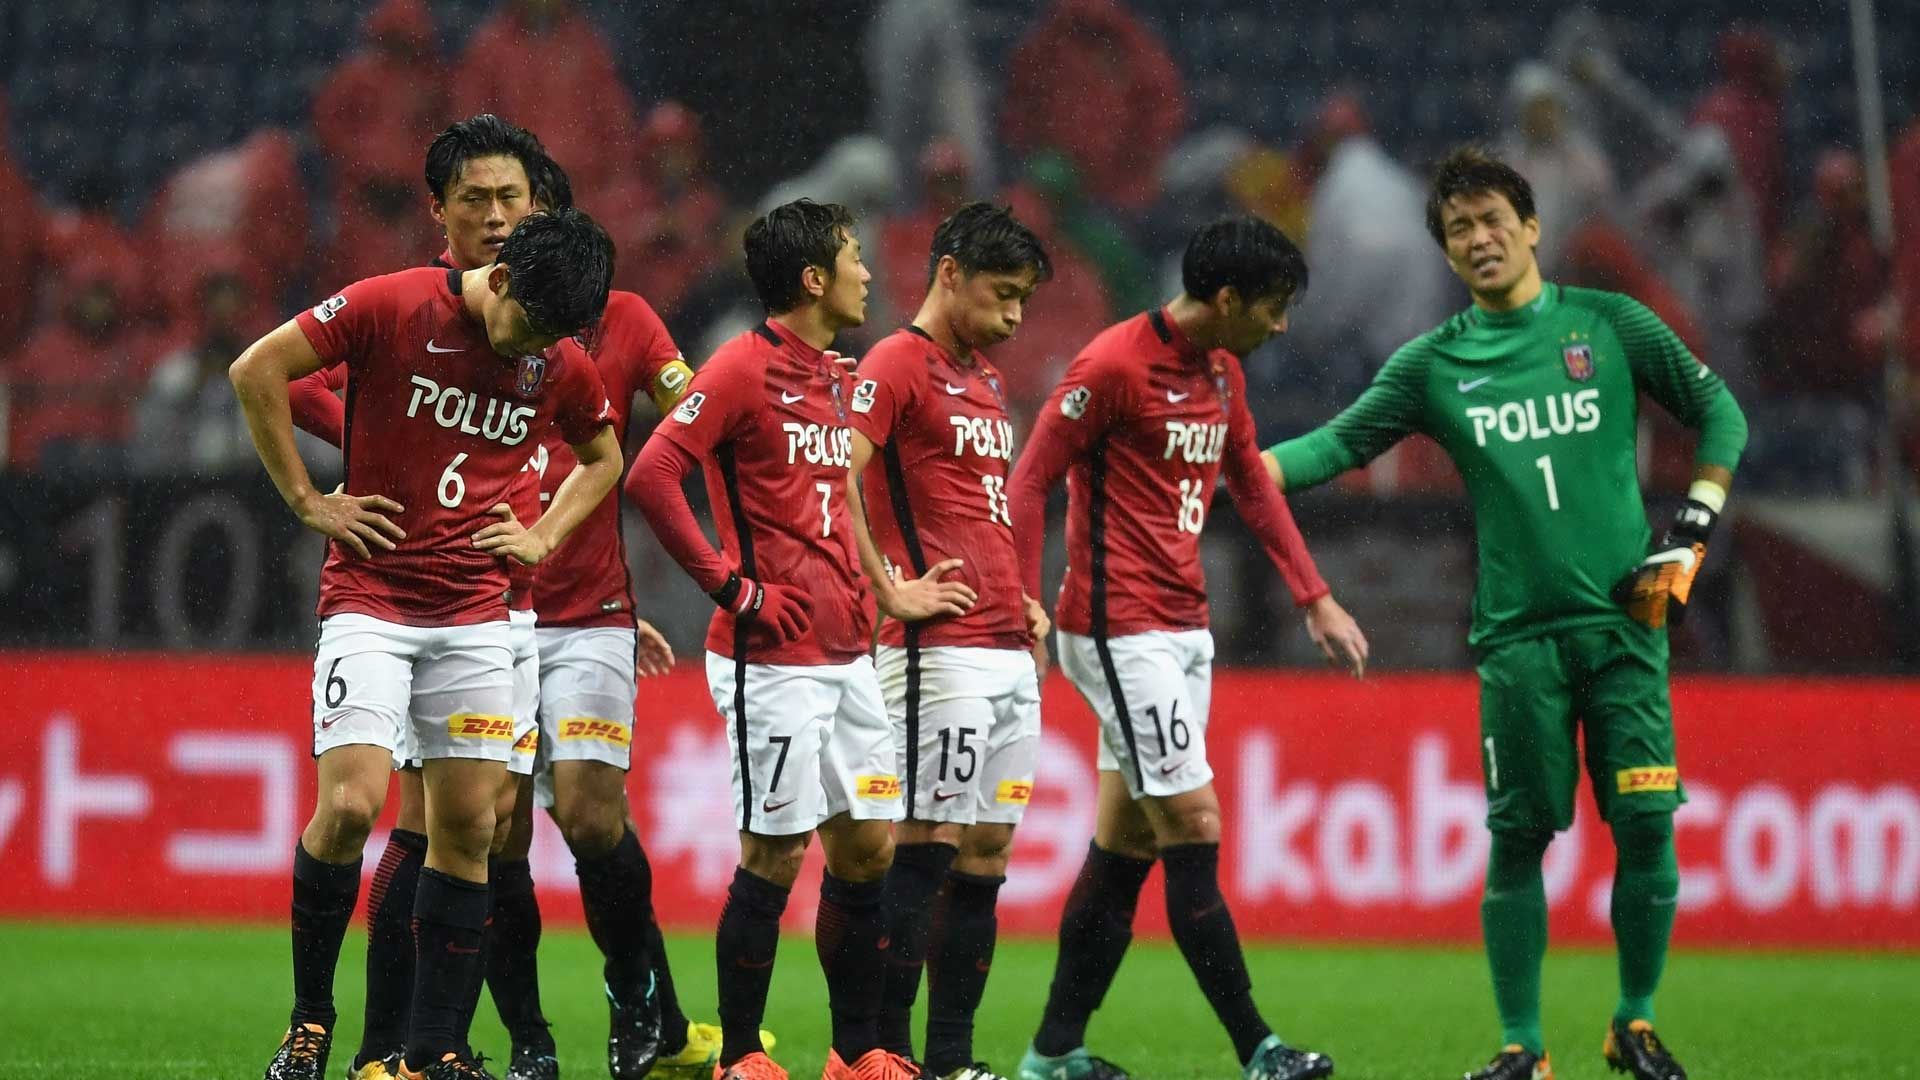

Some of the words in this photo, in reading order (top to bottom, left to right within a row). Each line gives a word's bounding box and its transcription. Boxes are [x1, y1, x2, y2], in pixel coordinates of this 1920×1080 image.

[407, 375, 536, 446] POLUS
[1466, 388, 1600, 447] POLUS
[950, 416, 1013, 462] POLU
[1164, 421, 1228, 464] POLU
[437, 453, 468, 508] 6
[1178, 478, 1204, 534] 16
[1536, 455, 1560, 510] 1
[816, 483, 831, 538] 7
[325, 656, 347, 709] 6
[565, 721, 624, 742] DHL
[937, 727, 976, 783] 15
[1145, 699, 1189, 757] 16
[769, 736, 792, 793] 7
[867, 779, 900, 795] DH
[1484, 736, 1499, 791] 1
